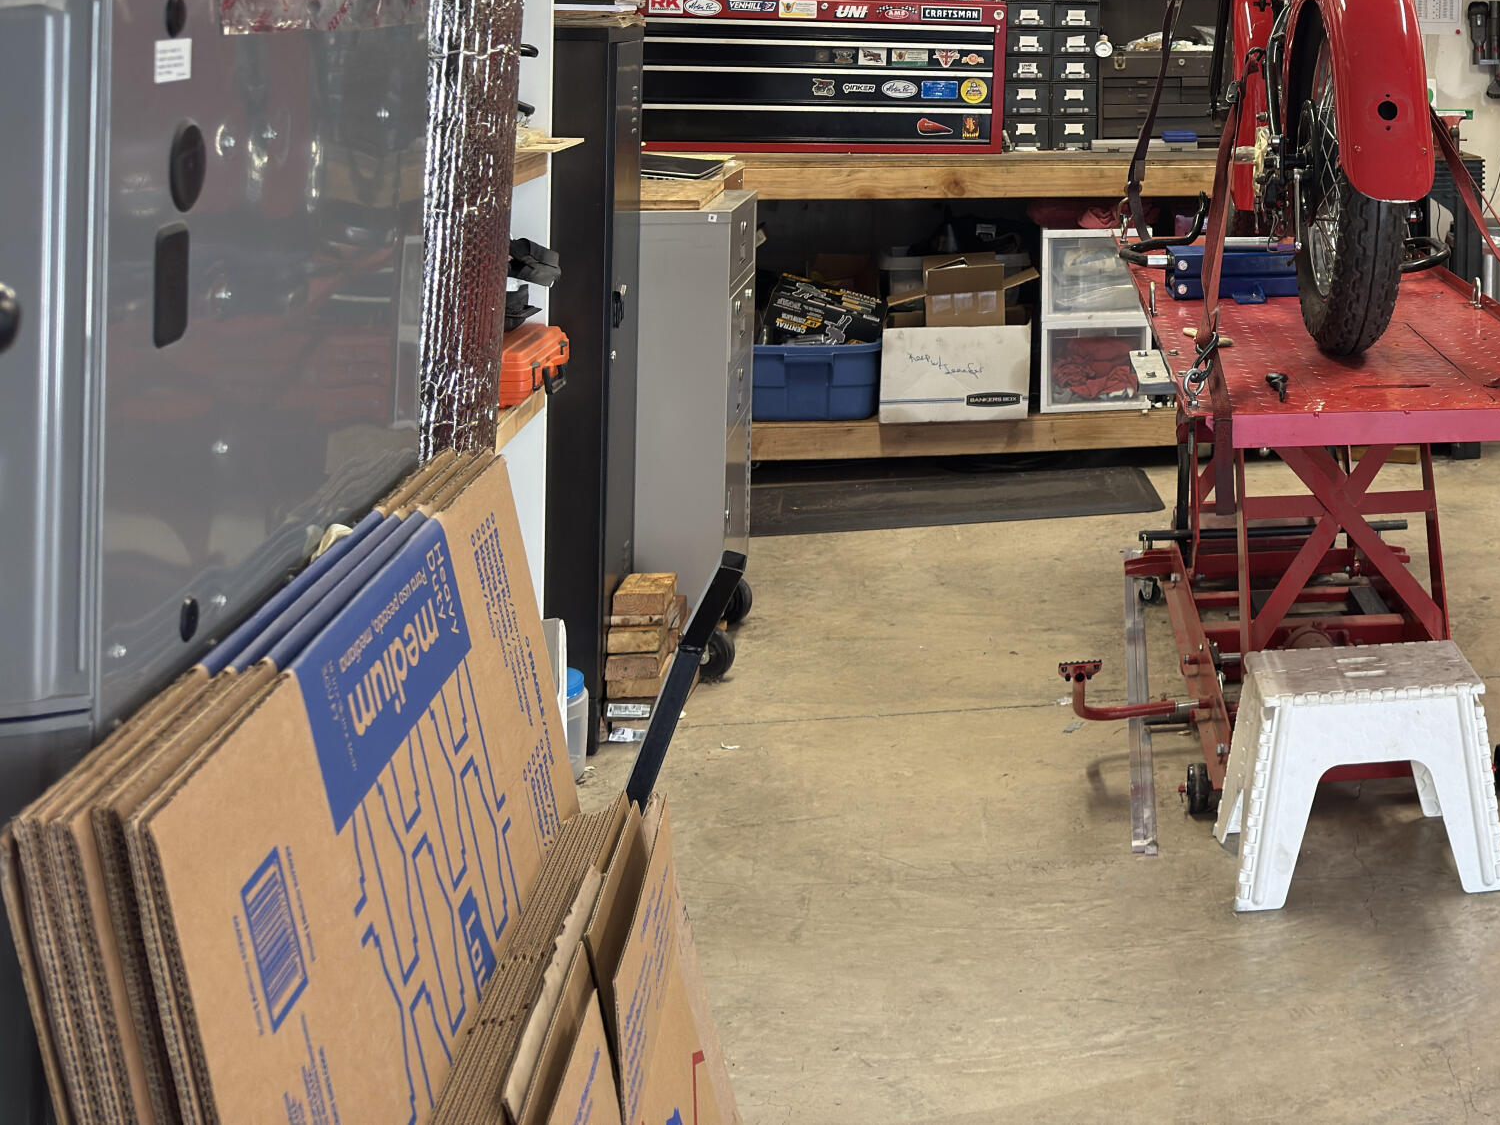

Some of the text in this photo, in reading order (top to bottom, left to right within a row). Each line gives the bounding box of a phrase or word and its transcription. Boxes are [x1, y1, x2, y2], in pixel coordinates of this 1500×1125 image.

[729, 0, 761, 10] VENHILL
[834, 5, 868, 18] UNI
[925, 10, 979, 19] CRAFTSMAN
[776, 321, 806, 334] CENTRAL
[398, 584, 411, 604] uso
[411, 567, 428, 591] Para
[426, 548, 446, 619] Duty
[434, 542, 460, 634] Heavy
[474, 550, 485, 590] Bath
[480, 544, 495, 607] Kitchen
[484, 539, 498, 592] Dining
[497, 593, 508, 639] Room
[489, 533, 502, 584] Family
[502, 588, 513, 633] Room
[494, 528, 511, 598] Bedroom
[339, 626, 373, 673] mediana
[347, 598, 439, 736] medium
[529, 651, 544, 718] FRAGILE
[531, 777, 546, 839] Garage
[535, 768, 550, 835] Laundry
